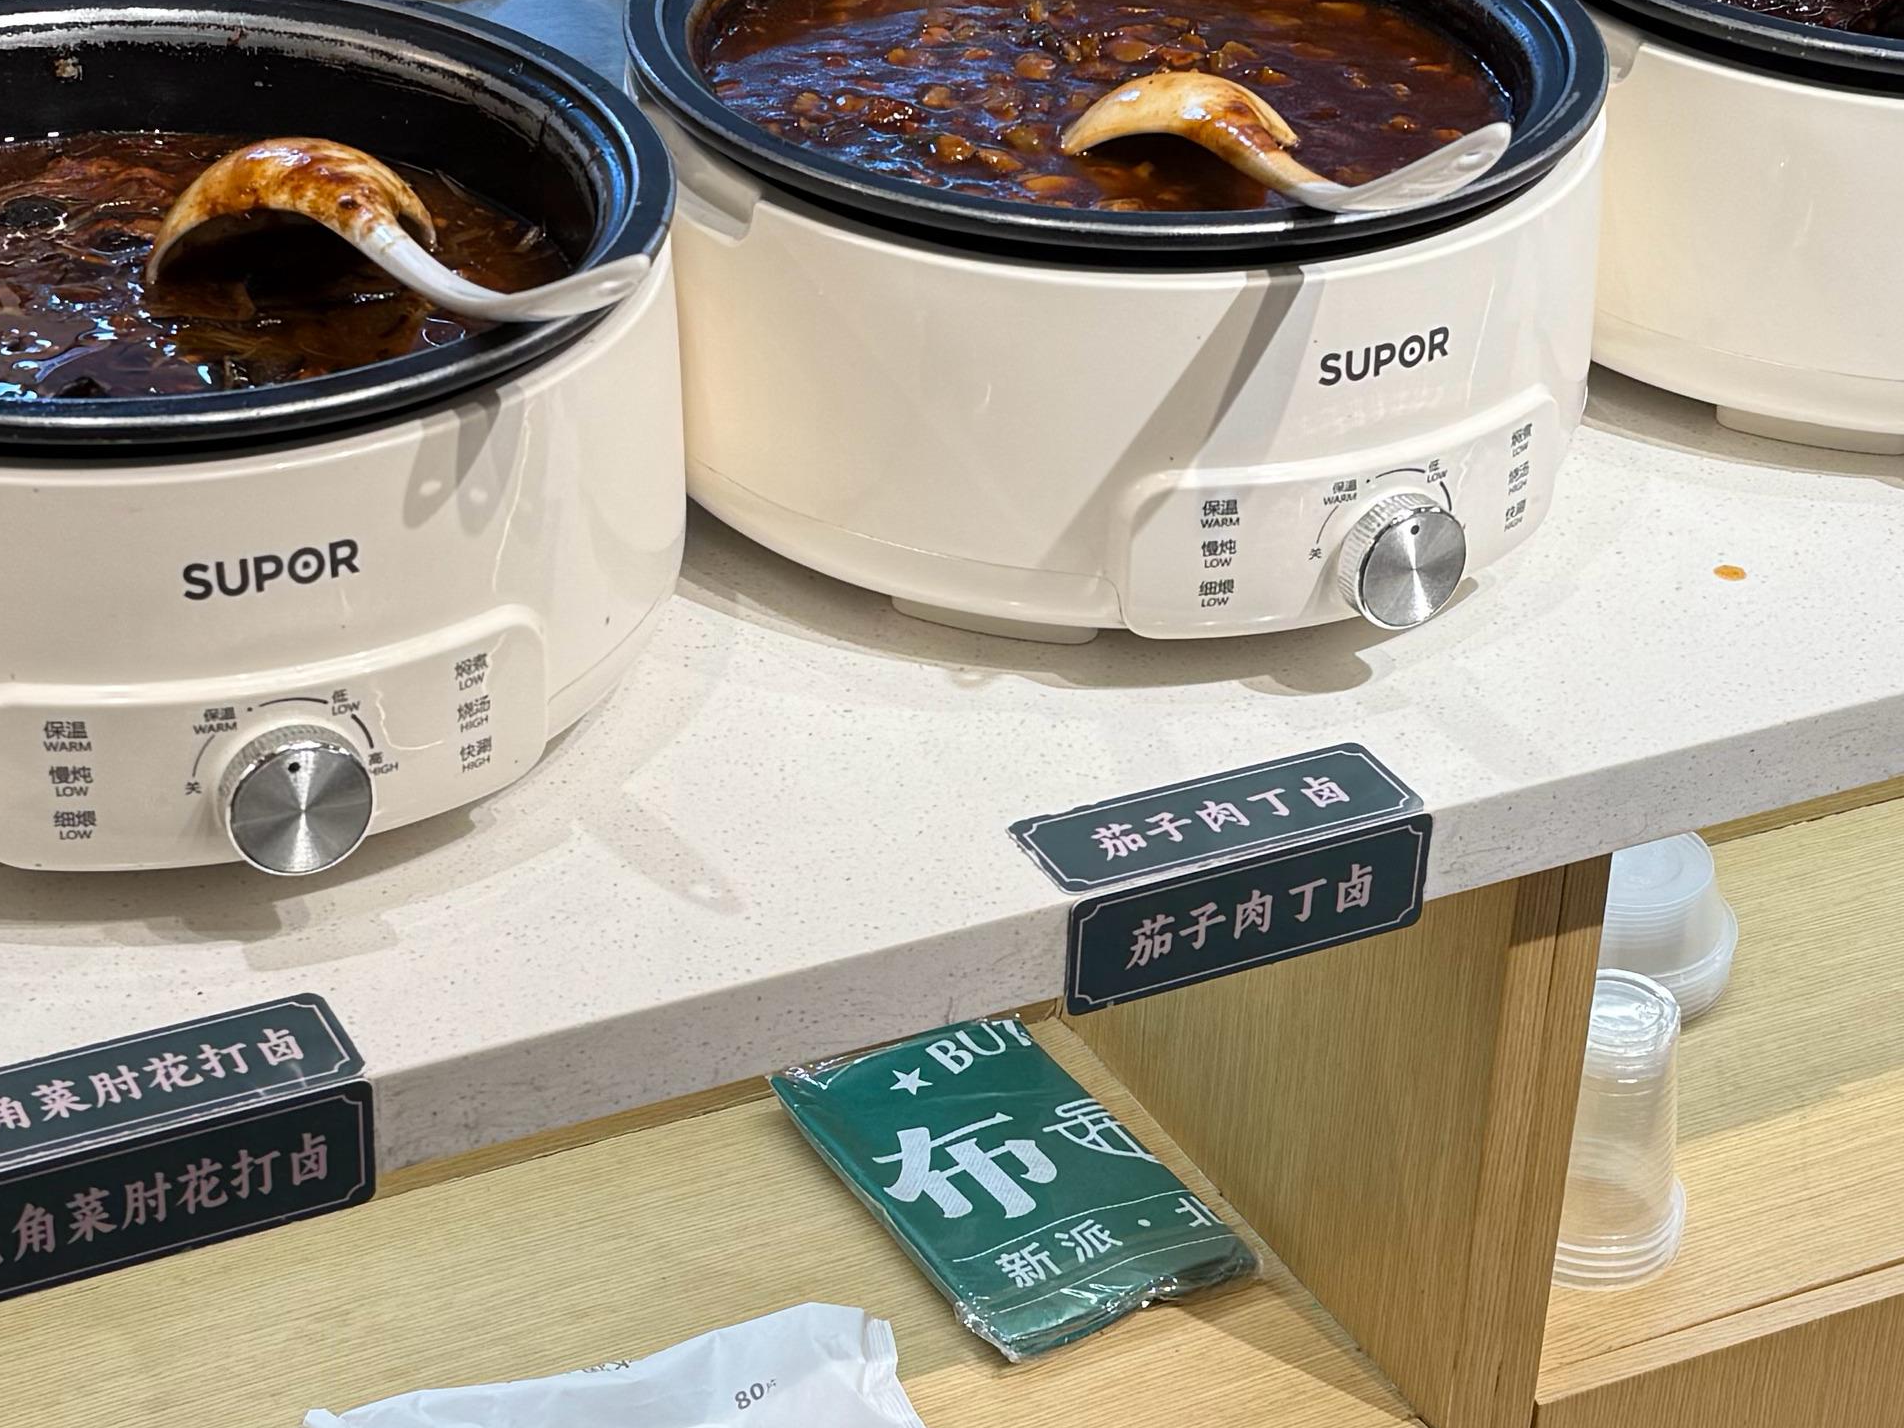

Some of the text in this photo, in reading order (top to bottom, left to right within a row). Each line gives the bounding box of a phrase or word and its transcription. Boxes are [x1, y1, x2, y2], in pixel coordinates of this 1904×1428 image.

[1318, 325, 1450, 387] SUPOR
[1323, 492, 1358, 506] WARM
[1203, 499, 1238, 517] 保温
[1200, 516, 1240, 529] WARM
[1201, 539, 1237, 557] 慢炖
[183, 539, 361, 601] SUPOR
[1204, 557, 1232, 569] LOW
[1201, 596, 1229, 608] LOW
[459, 671, 485, 691] LOW
[203, 707, 235, 722] 保温
[331, 701, 361, 716] LOW
[44, 720, 88, 740] 保温
[193, 721, 238, 734] WARM
[43, 740, 92, 753] WARM
[49, 765, 93, 785] 慢炖
[55, 785, 88, 798] LOW
[1091, 775, 1351, 862] 茄子肉丁卤
[59, 828, 92, 840] LOW
[1125, 863, 1375, 972] 茄子肉丁卤
[872, 1112, 1057, 1219] 布
